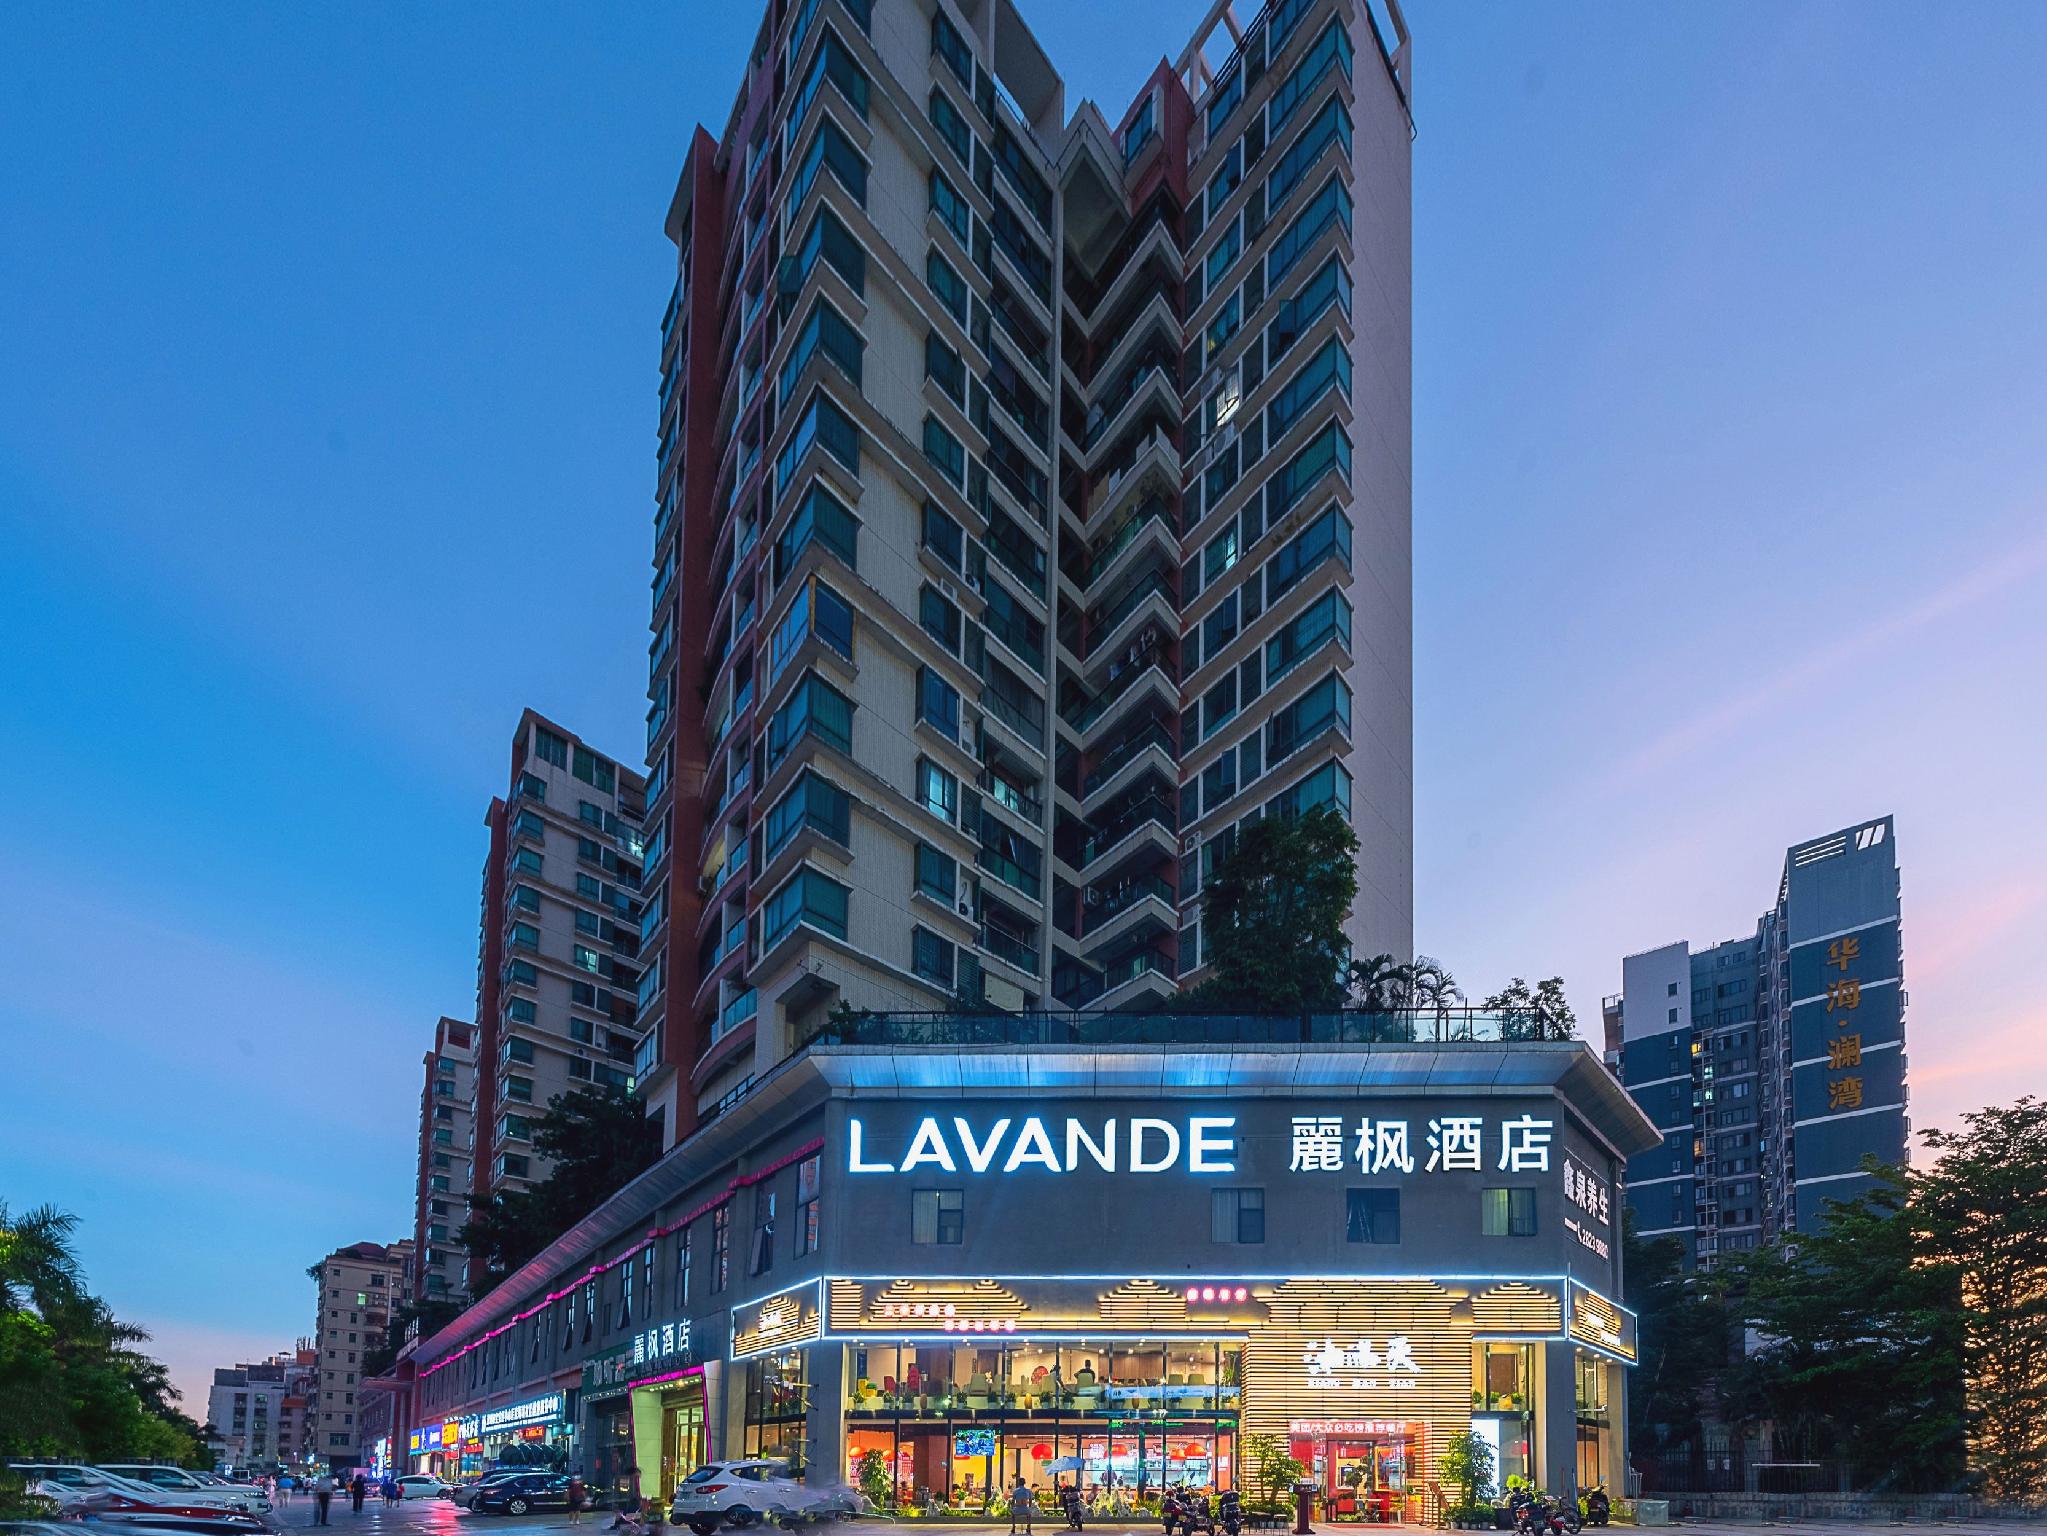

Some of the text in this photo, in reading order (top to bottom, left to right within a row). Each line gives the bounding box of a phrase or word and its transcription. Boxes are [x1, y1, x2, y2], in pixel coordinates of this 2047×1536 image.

[849, 1114, 1553, 1174] LAVANDE 麗枫酒店
